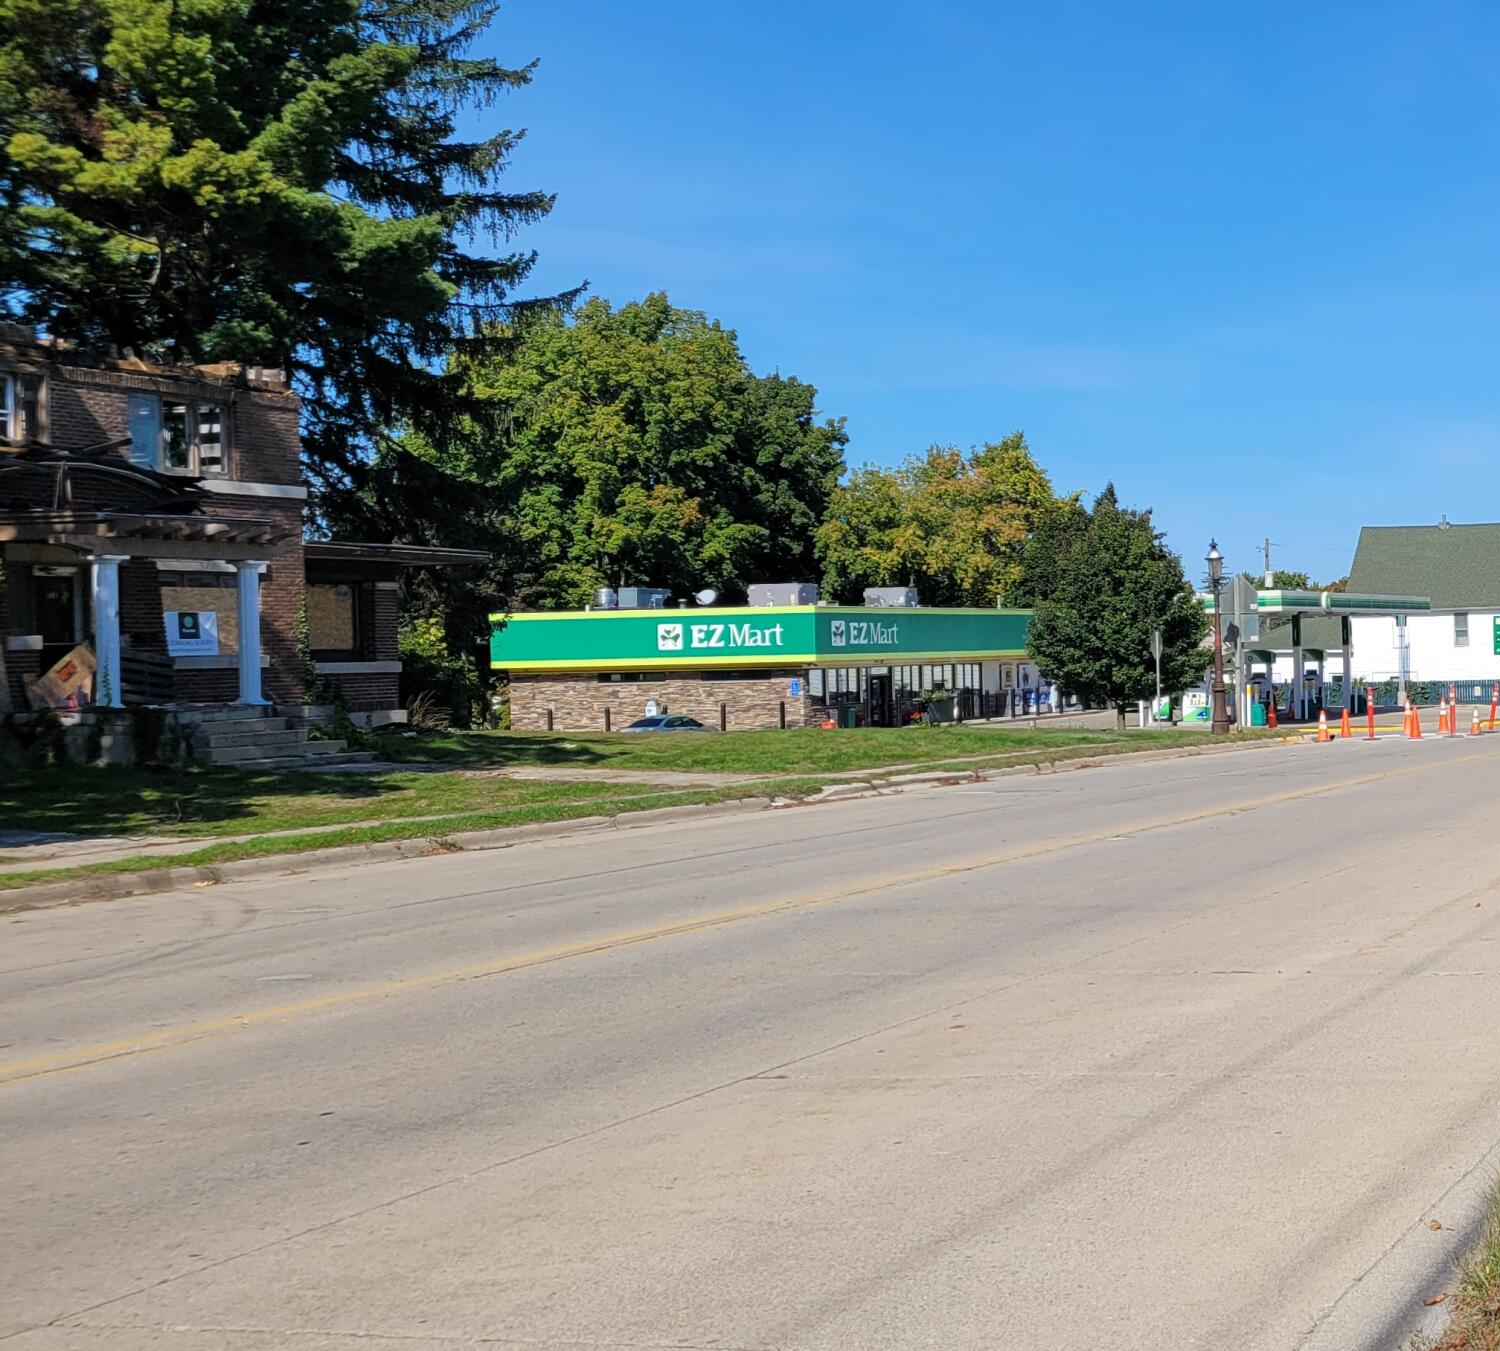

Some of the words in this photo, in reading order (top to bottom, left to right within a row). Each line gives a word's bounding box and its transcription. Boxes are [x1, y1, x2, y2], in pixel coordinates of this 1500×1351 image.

[690, 624, 725, 648] EZ
[728, 622, 784, 648] Mart
[849, 622, 868, 645] EZ
[869, 622, 899, 645] Mart
